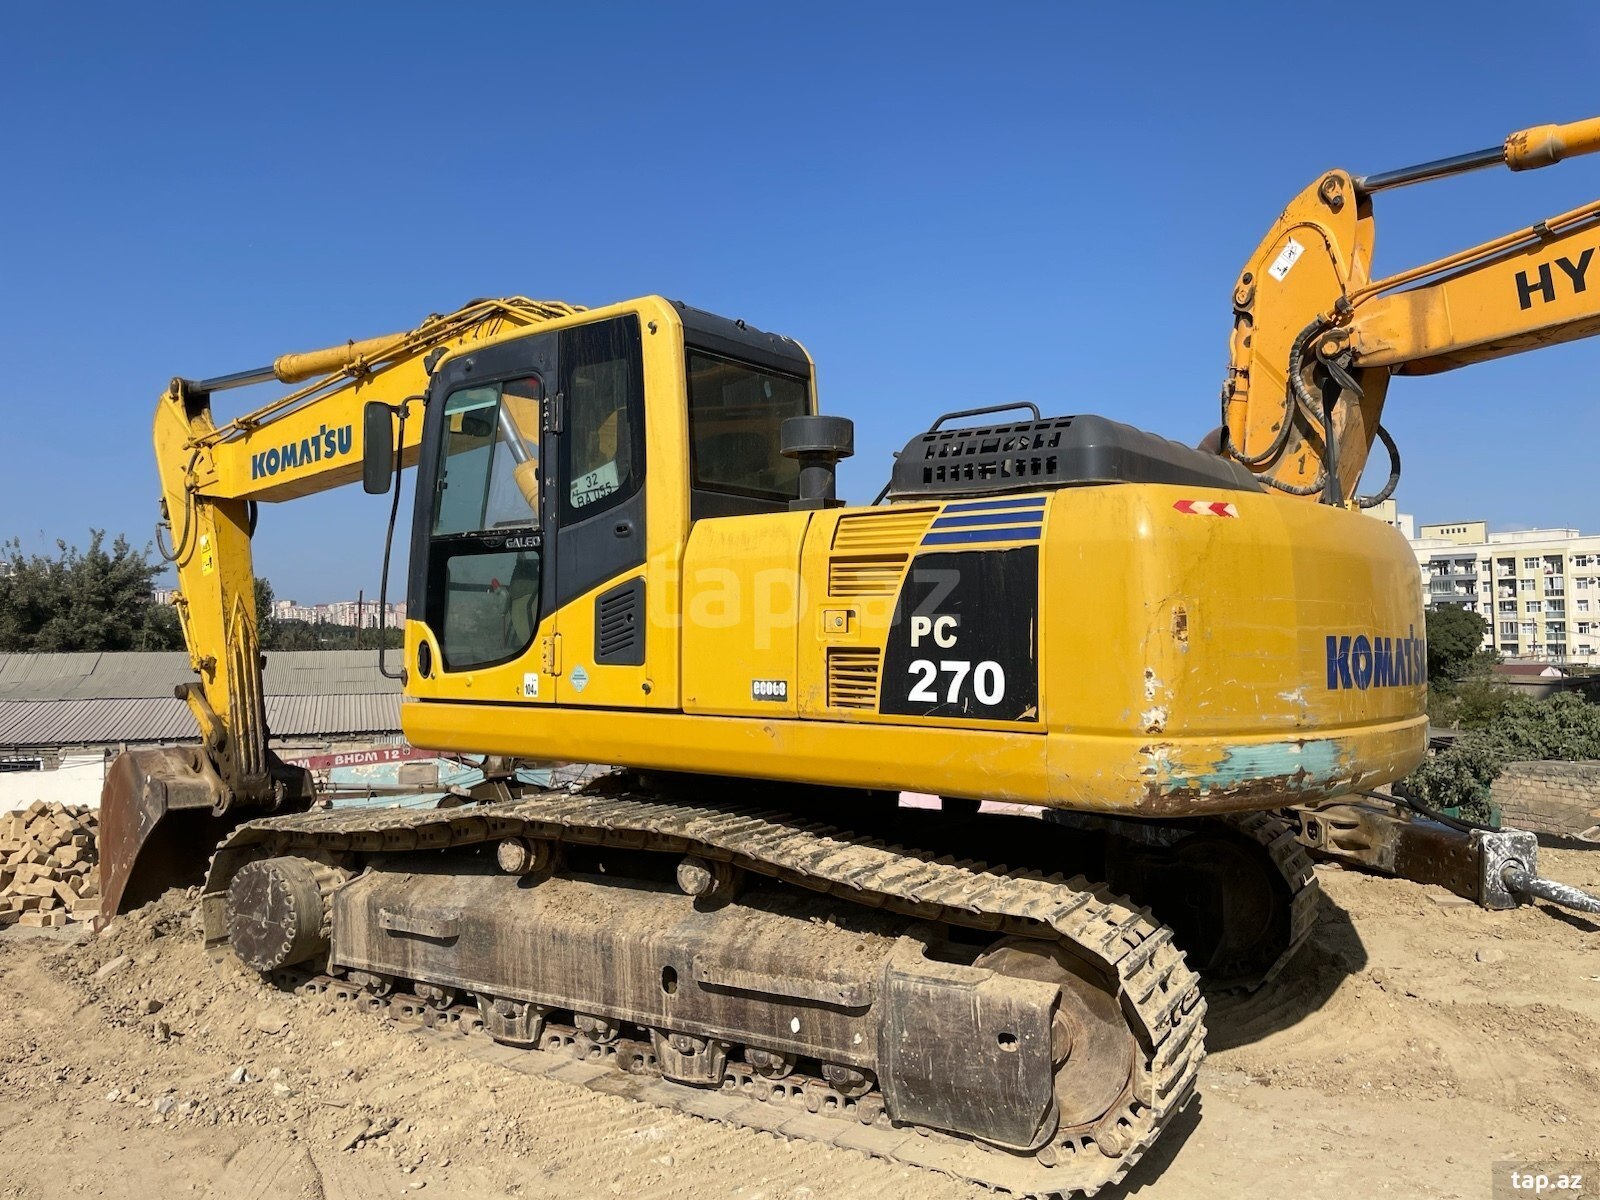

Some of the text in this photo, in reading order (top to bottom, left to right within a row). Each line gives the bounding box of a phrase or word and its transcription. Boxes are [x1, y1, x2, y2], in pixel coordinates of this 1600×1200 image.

[1515, 246, 1600, 311] HY
[252, 424, 352, 480] KOMATSU
[585, 472, 599, 488] 32
[505, 536, 541, 549] GALEO
[910, 616, 957, 649] PC
[907, 660, 1006, 706] 270
[334, 752, 378, 766] BHDM
[383, 750, 400, 760] 12
